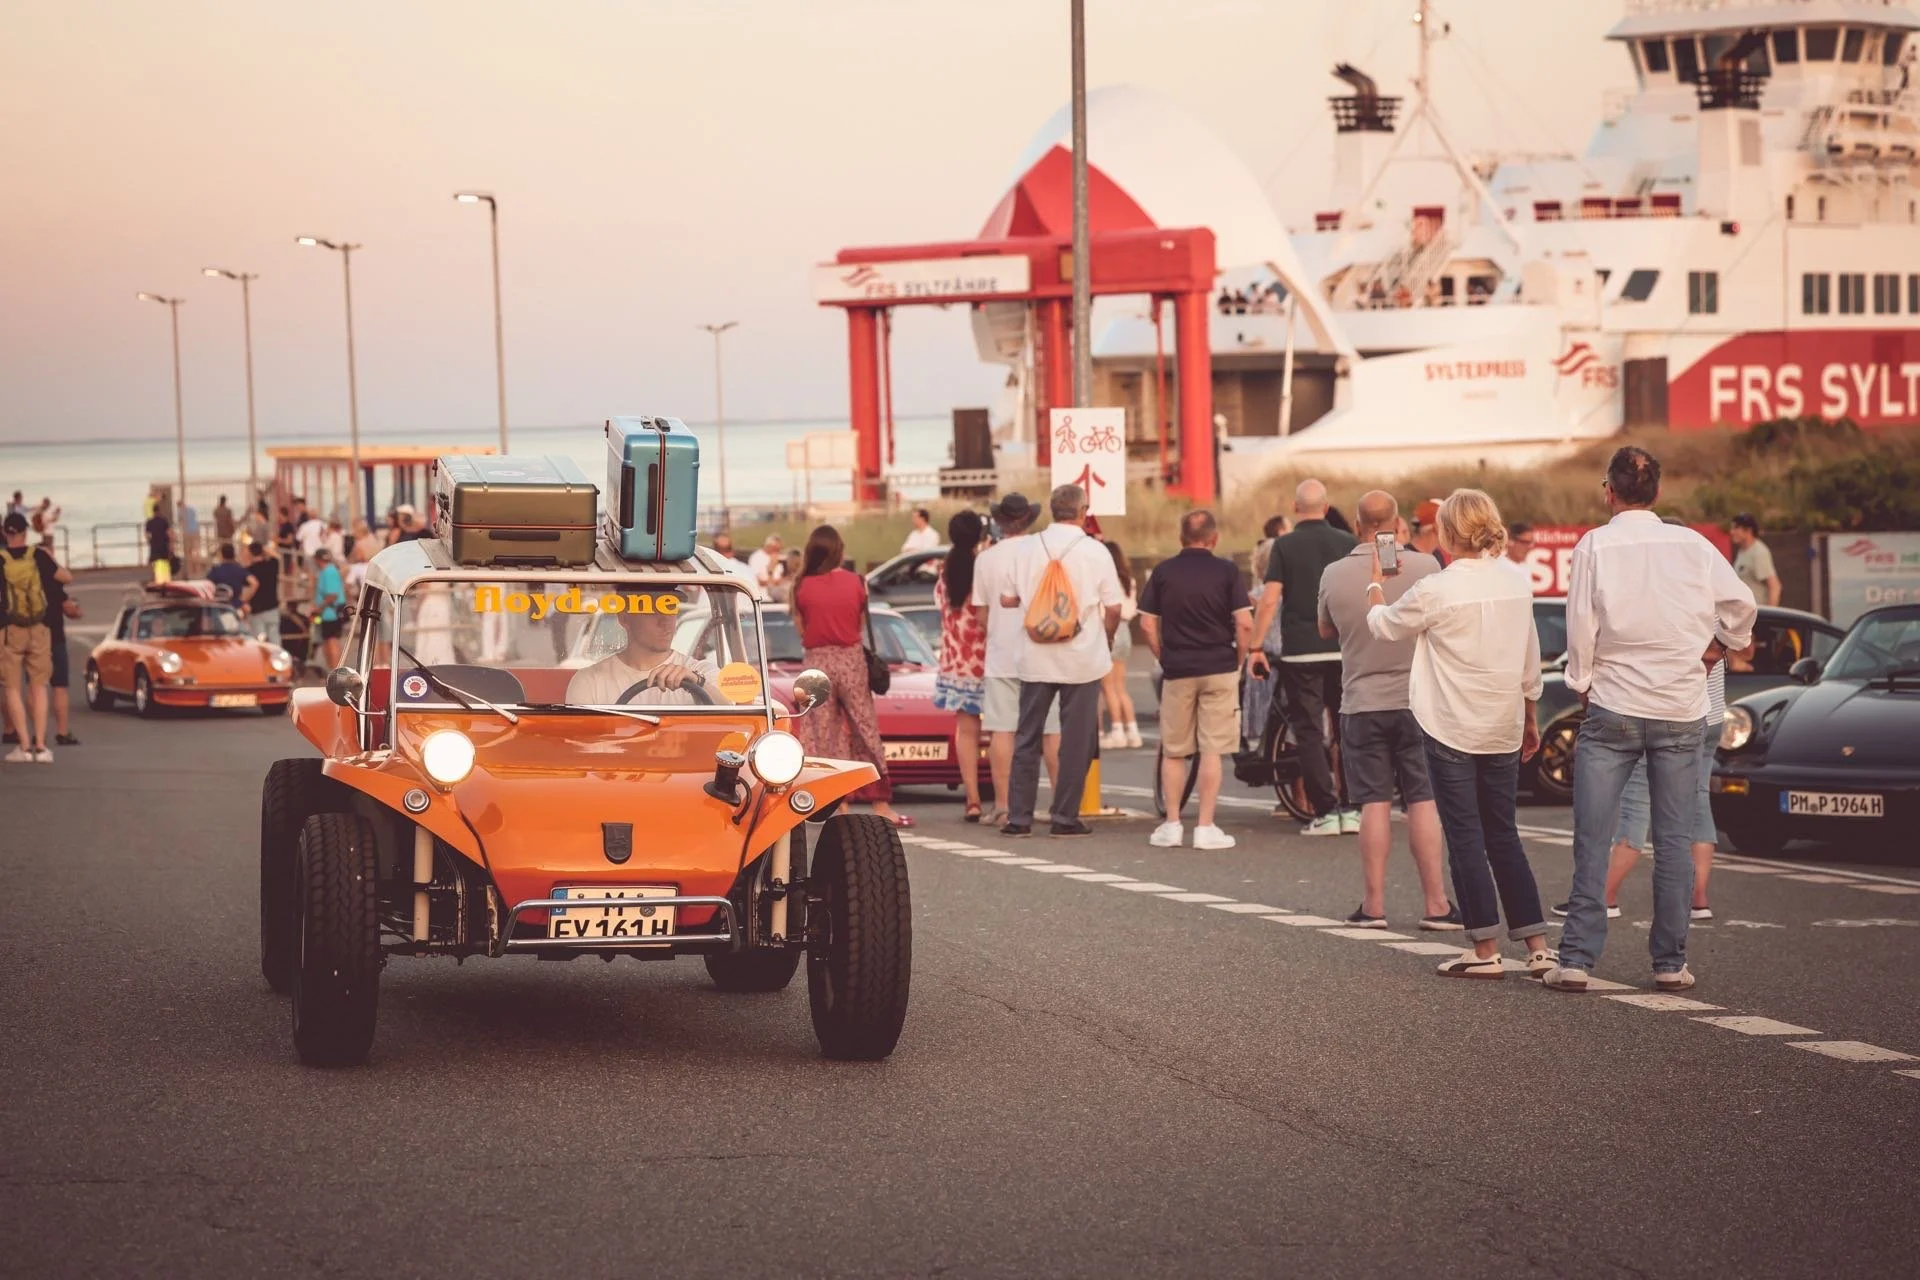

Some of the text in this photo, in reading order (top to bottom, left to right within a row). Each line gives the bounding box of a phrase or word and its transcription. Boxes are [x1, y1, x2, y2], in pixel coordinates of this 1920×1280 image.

[1582, 366, 1618, 388] FRS
[1710, 364, 1804, 421] FRS
[473, 585, 680, 620] floyd.one
[1790, 794, 1808, 811] PM
[604, 892, 624, 916] M
